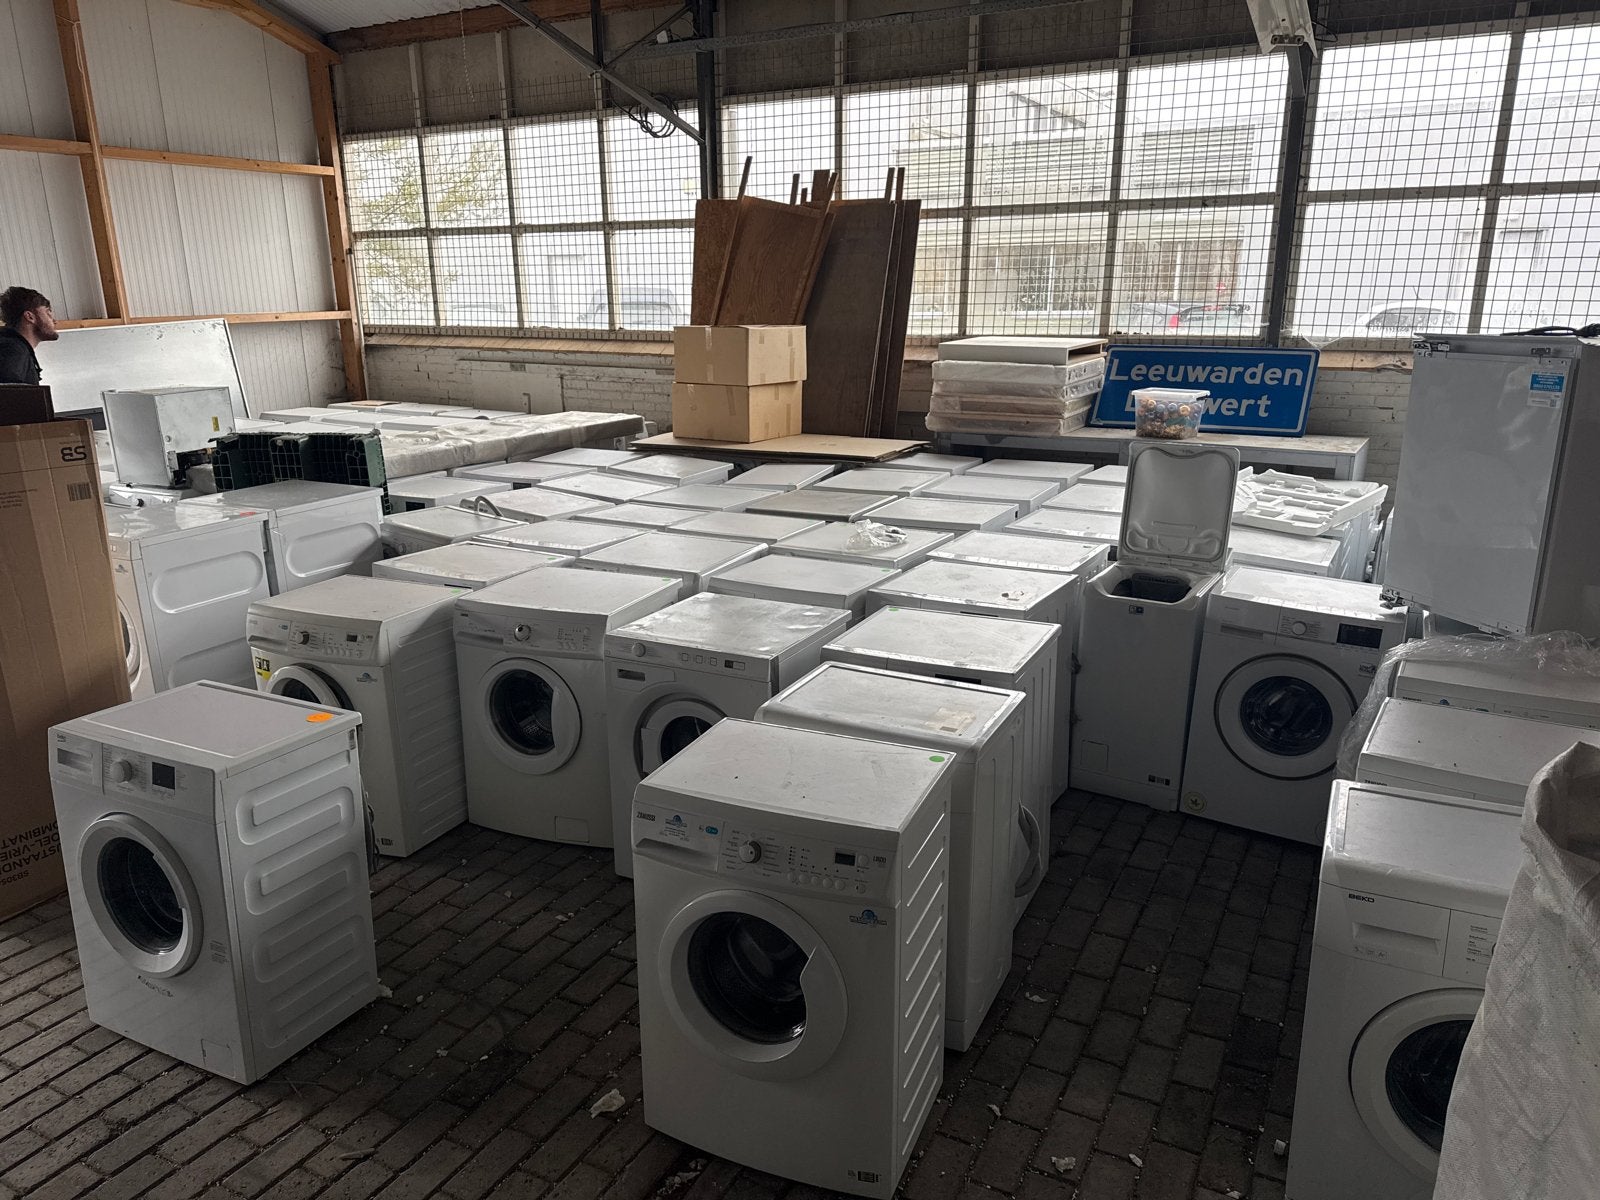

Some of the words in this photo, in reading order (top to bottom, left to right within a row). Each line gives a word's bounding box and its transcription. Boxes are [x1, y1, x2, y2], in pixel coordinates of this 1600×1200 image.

[1109, 358, 1304, 386] Leeuwarden
[1124, 390, 1272, 417] Lwert
[0, 832, 60, 862] OEL-VRIE
[1, 820, 59, 850] OMBINAT
[0, 842, 61, 875] JSTAAND
[0, 869, 29, 887] SB305
[1348, 893, 1375, 903] BEKO
